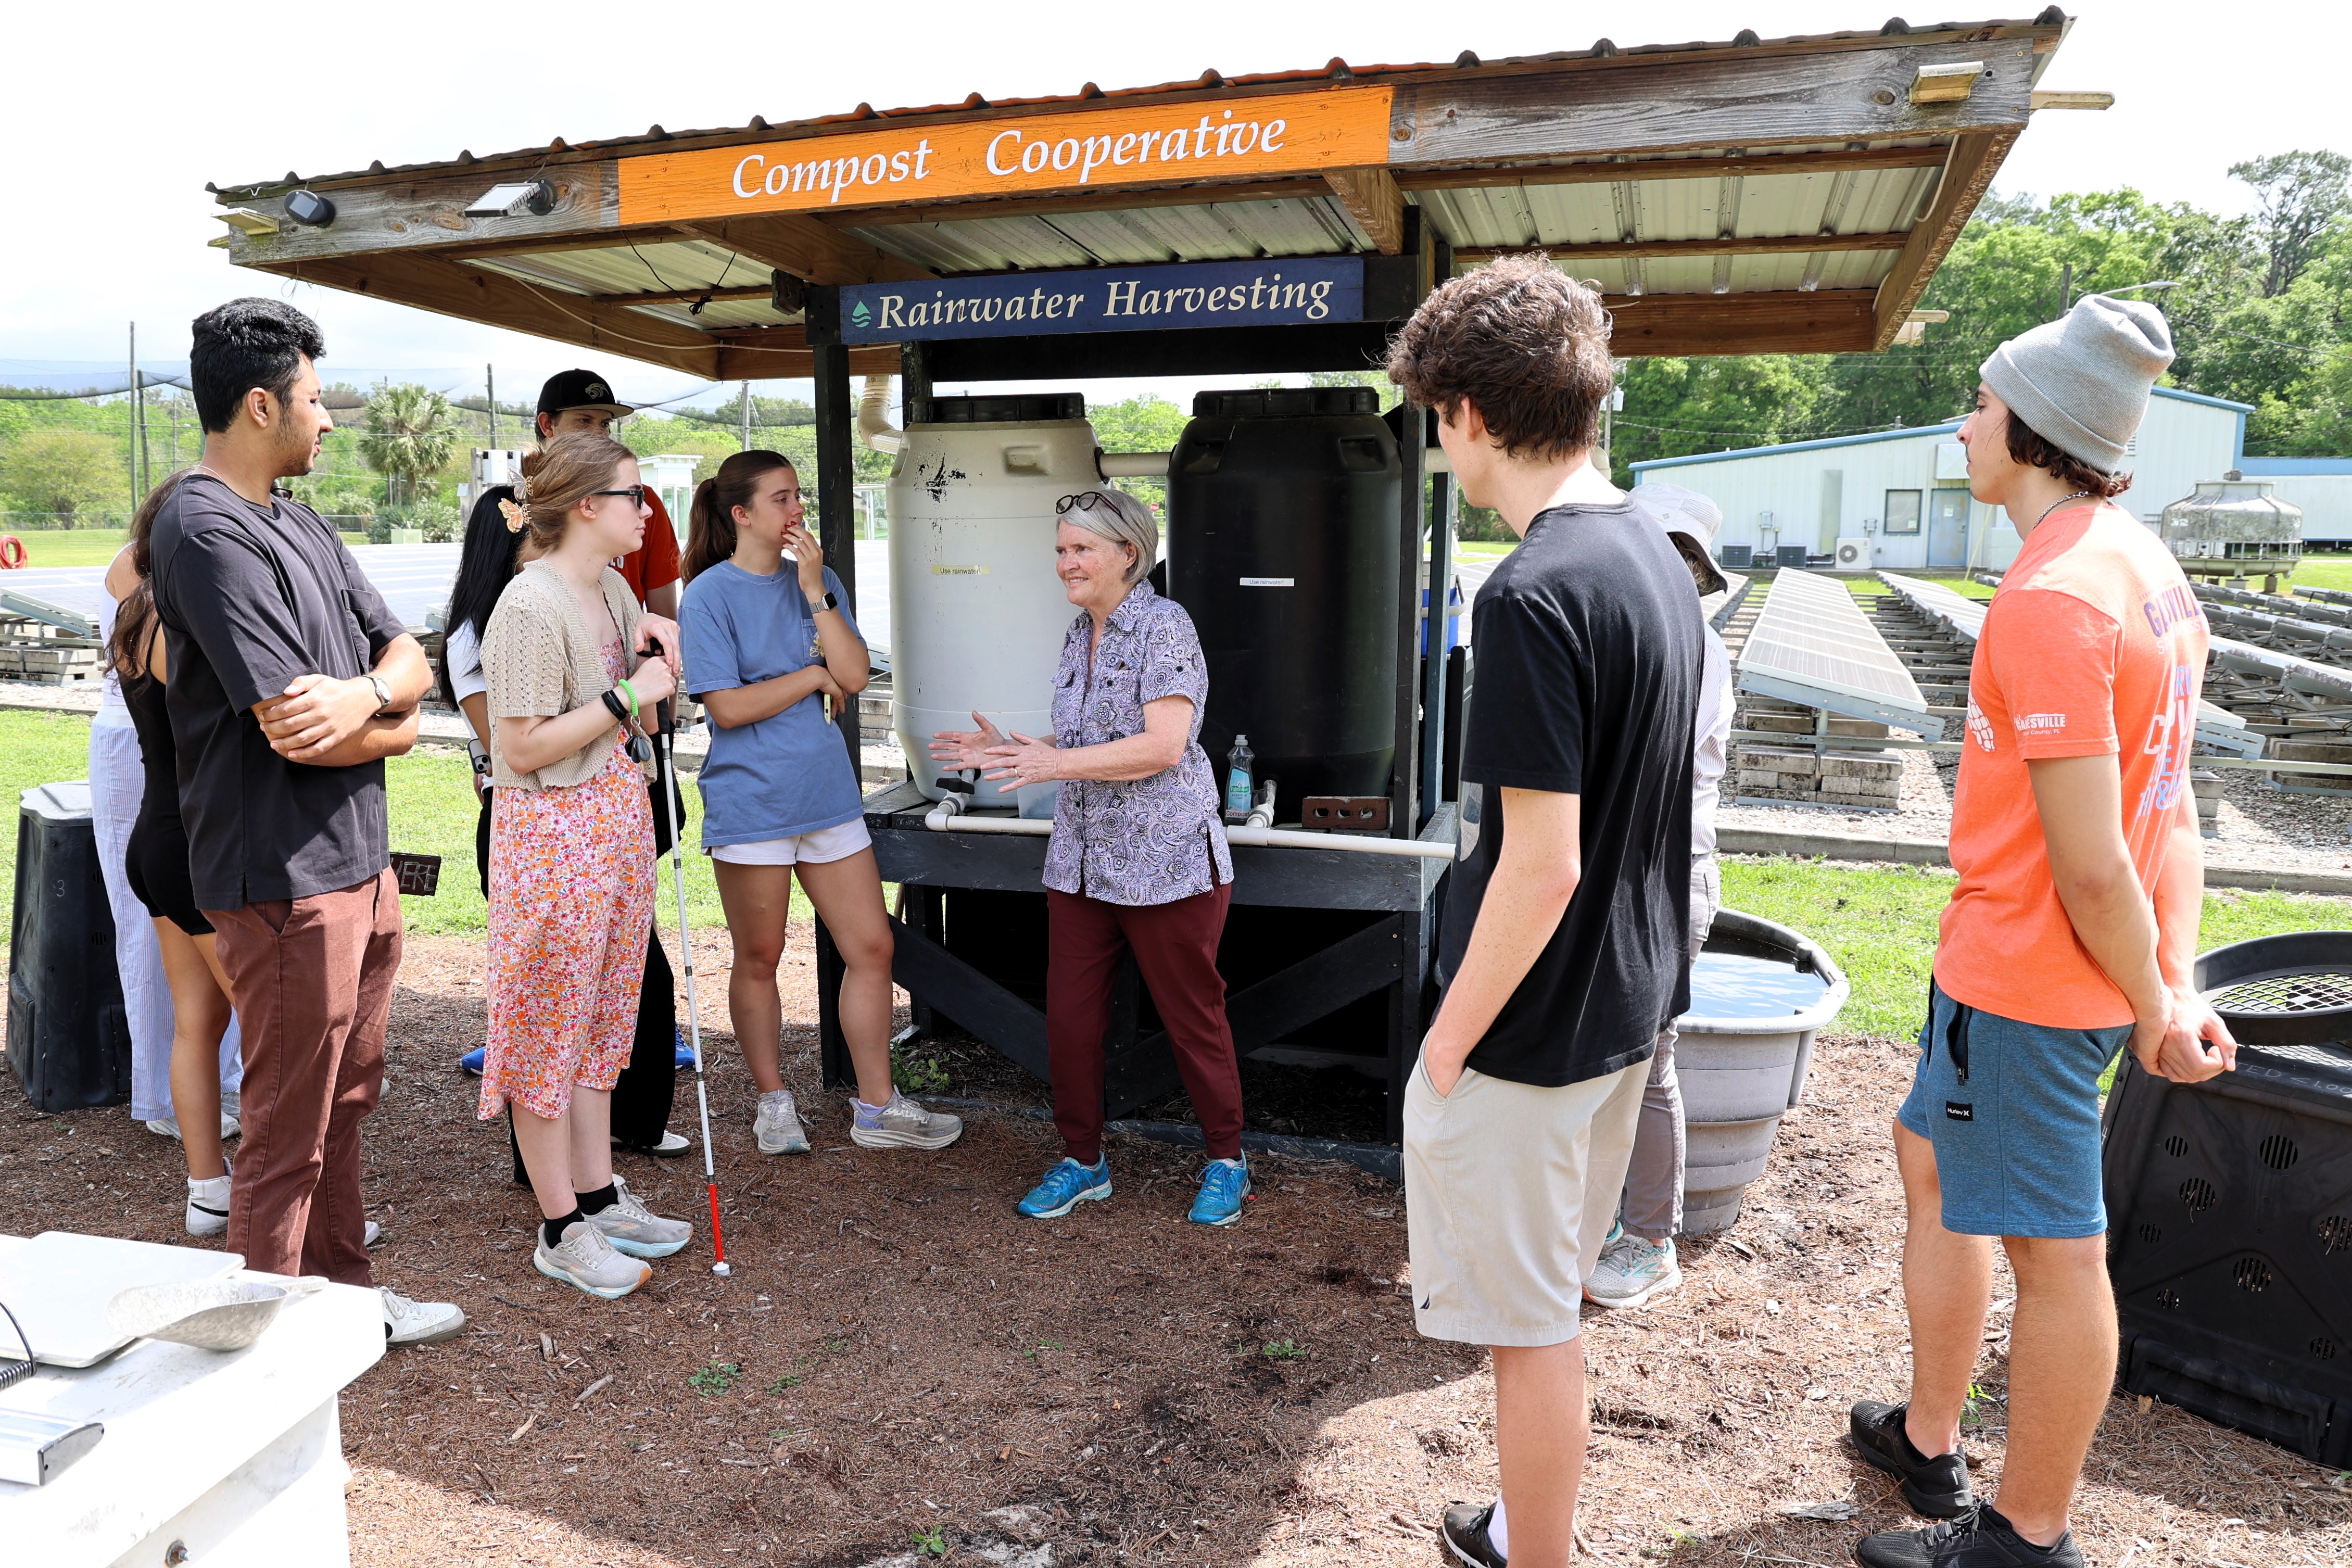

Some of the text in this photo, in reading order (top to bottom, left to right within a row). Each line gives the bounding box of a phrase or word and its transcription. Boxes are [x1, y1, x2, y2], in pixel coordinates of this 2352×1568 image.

[733, 109, 1286, 204] Compost Cooperative
[877, 273, 1333, 328] Rainwater Harvesting
[56, 879, 65, 897] 3
[856, 1116, 884, 1130] HOKA
[2101, 1124, 2108, 1145] 4
